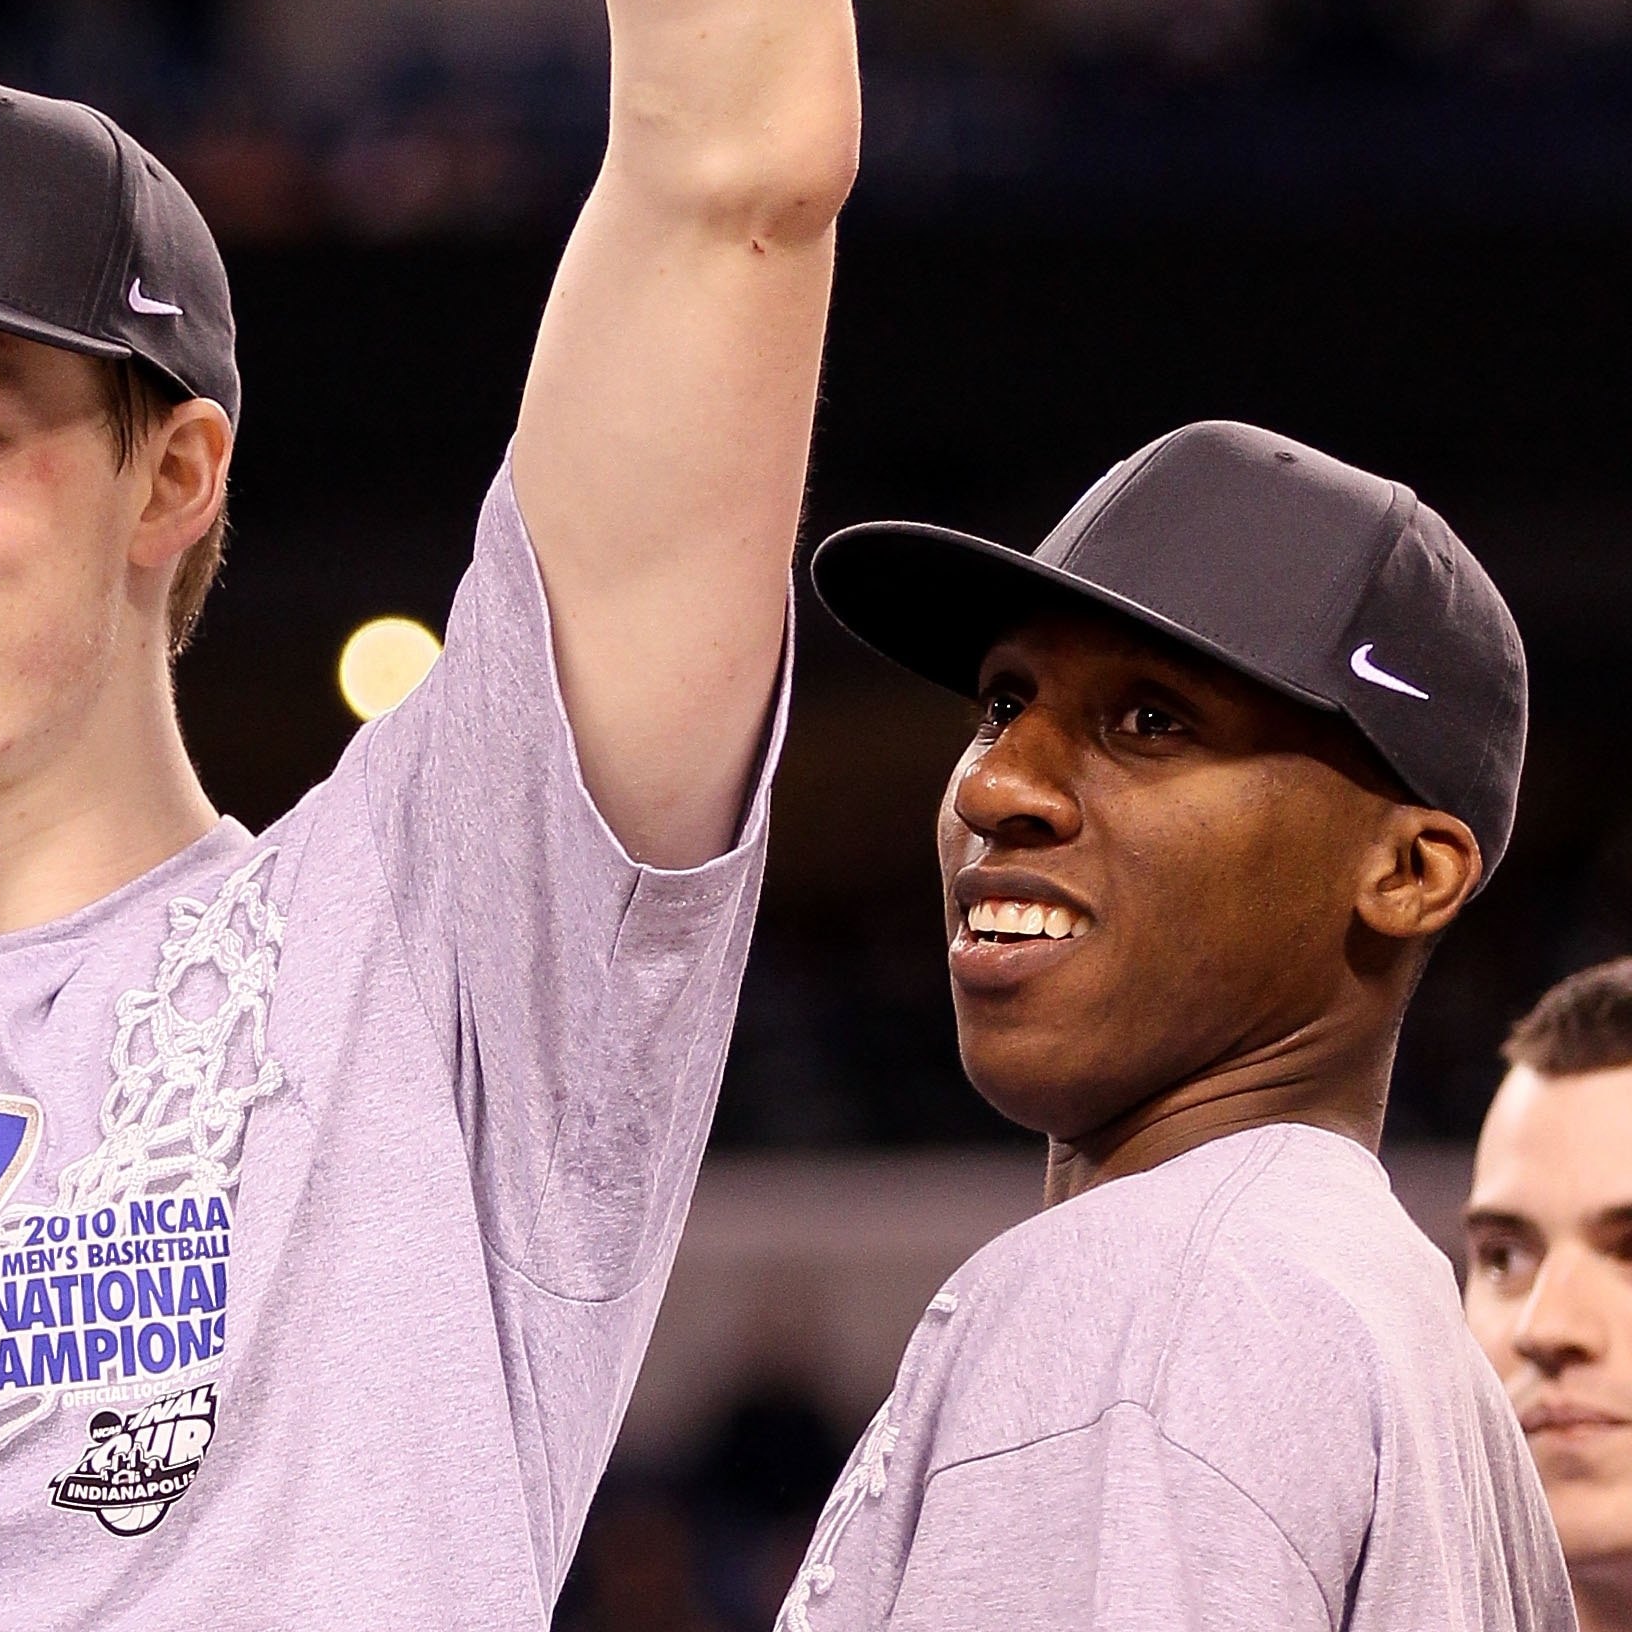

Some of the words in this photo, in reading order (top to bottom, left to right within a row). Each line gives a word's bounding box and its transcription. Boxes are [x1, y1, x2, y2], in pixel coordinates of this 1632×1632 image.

[24, 1207, 117, 1247] 2010
[129, 1196, 231, 1236] NCAA
[2, 1245, 78, 1277] MEN'S
[62, 1384, 131, 1409] OFFICIAL
[67, 1469, 196, 1501] INDIANAPOLIS
